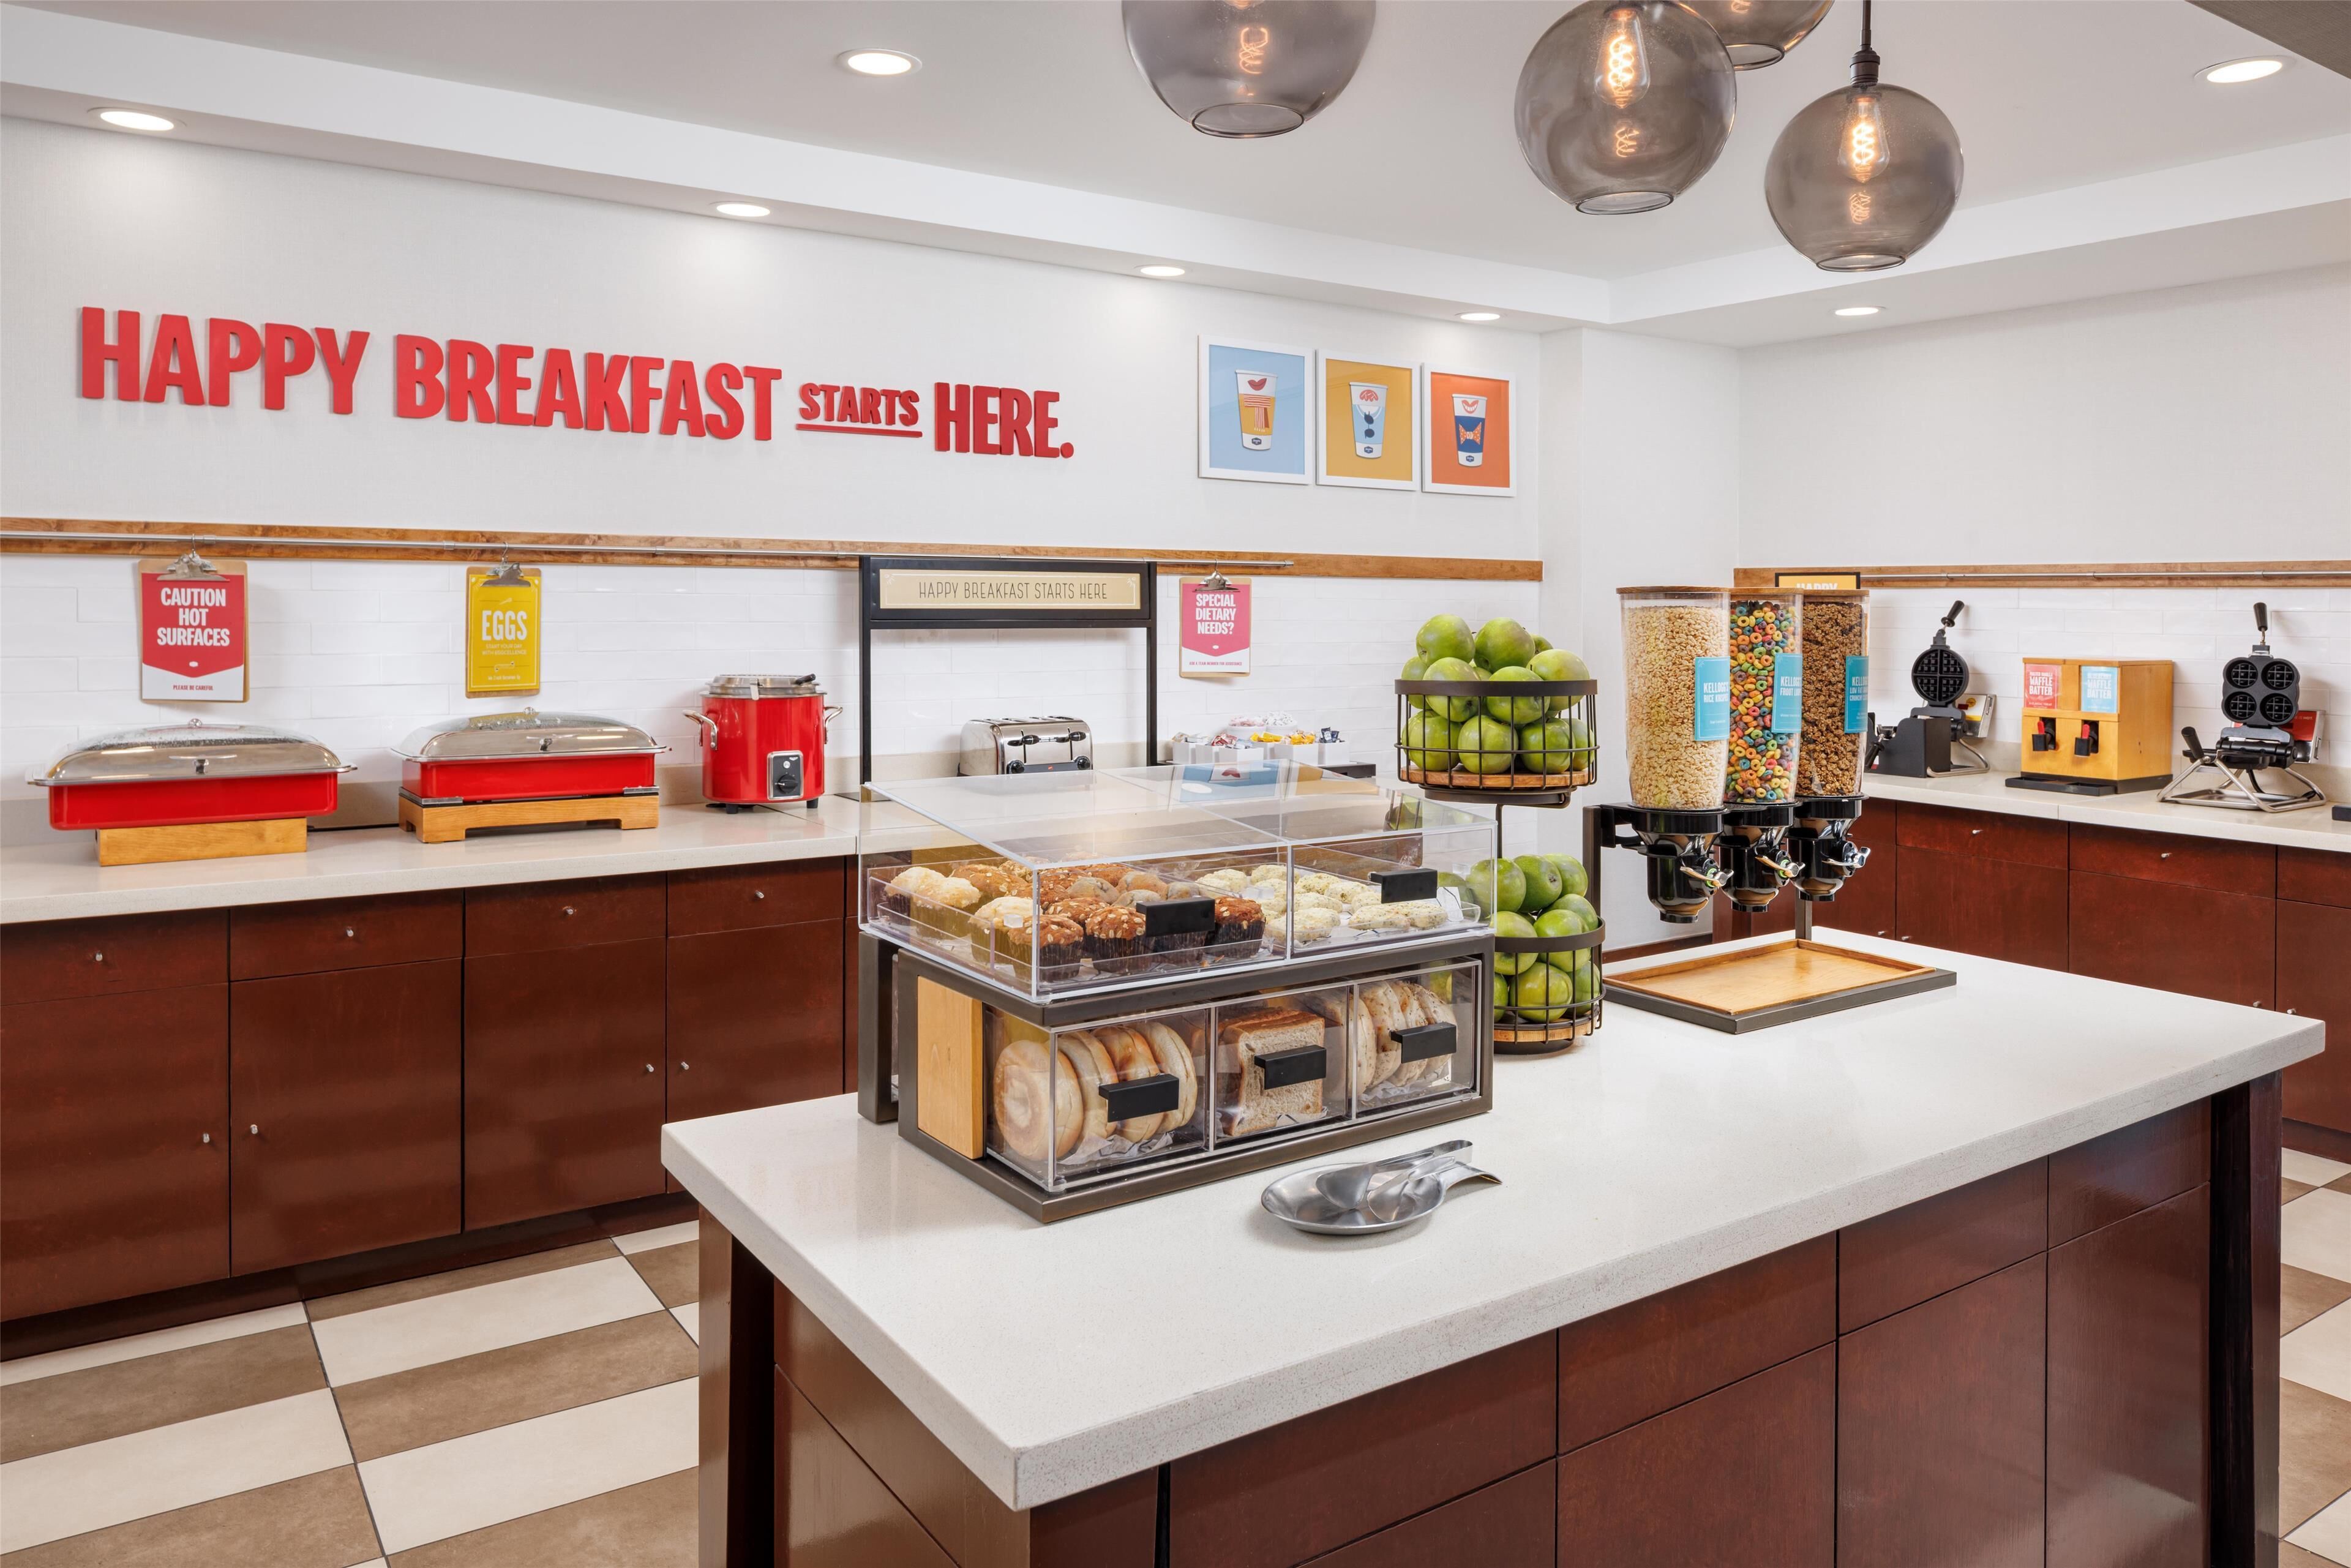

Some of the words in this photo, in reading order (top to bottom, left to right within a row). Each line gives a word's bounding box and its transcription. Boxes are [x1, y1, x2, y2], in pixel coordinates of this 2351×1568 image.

[82, 307, 370, 415] HAPPY
[396, 334, 782, 441] BREAKFAST
[800, 383, 920, 426] STARTS
[934, 382, 1074, 458] HERE.
[160, 587, 227, 607] CAUTION
[919, 582, 958, 598] HAPPY
[964, 582, 1030, 599] BREAKFAST
[1035, 583, 1074, 599] STARTS
[1079, 583, 1108, 599] HERE
[1196, 593, 1236, 607] SPECIAL
[178, 607, 209, 626] HOT
[1195, 607, 1237, 621] DIETARY
[482, 610, 528, 641] EGGS
[1197, 621, 1235, 635] NEEDS?
[157, 627, 230, 647] SURFACES
[2030, 677, 2053, 686] WAFFLE
[2029, 685, 2053, 696] BATTER
[1703, 694, 1714, 703] RICE
